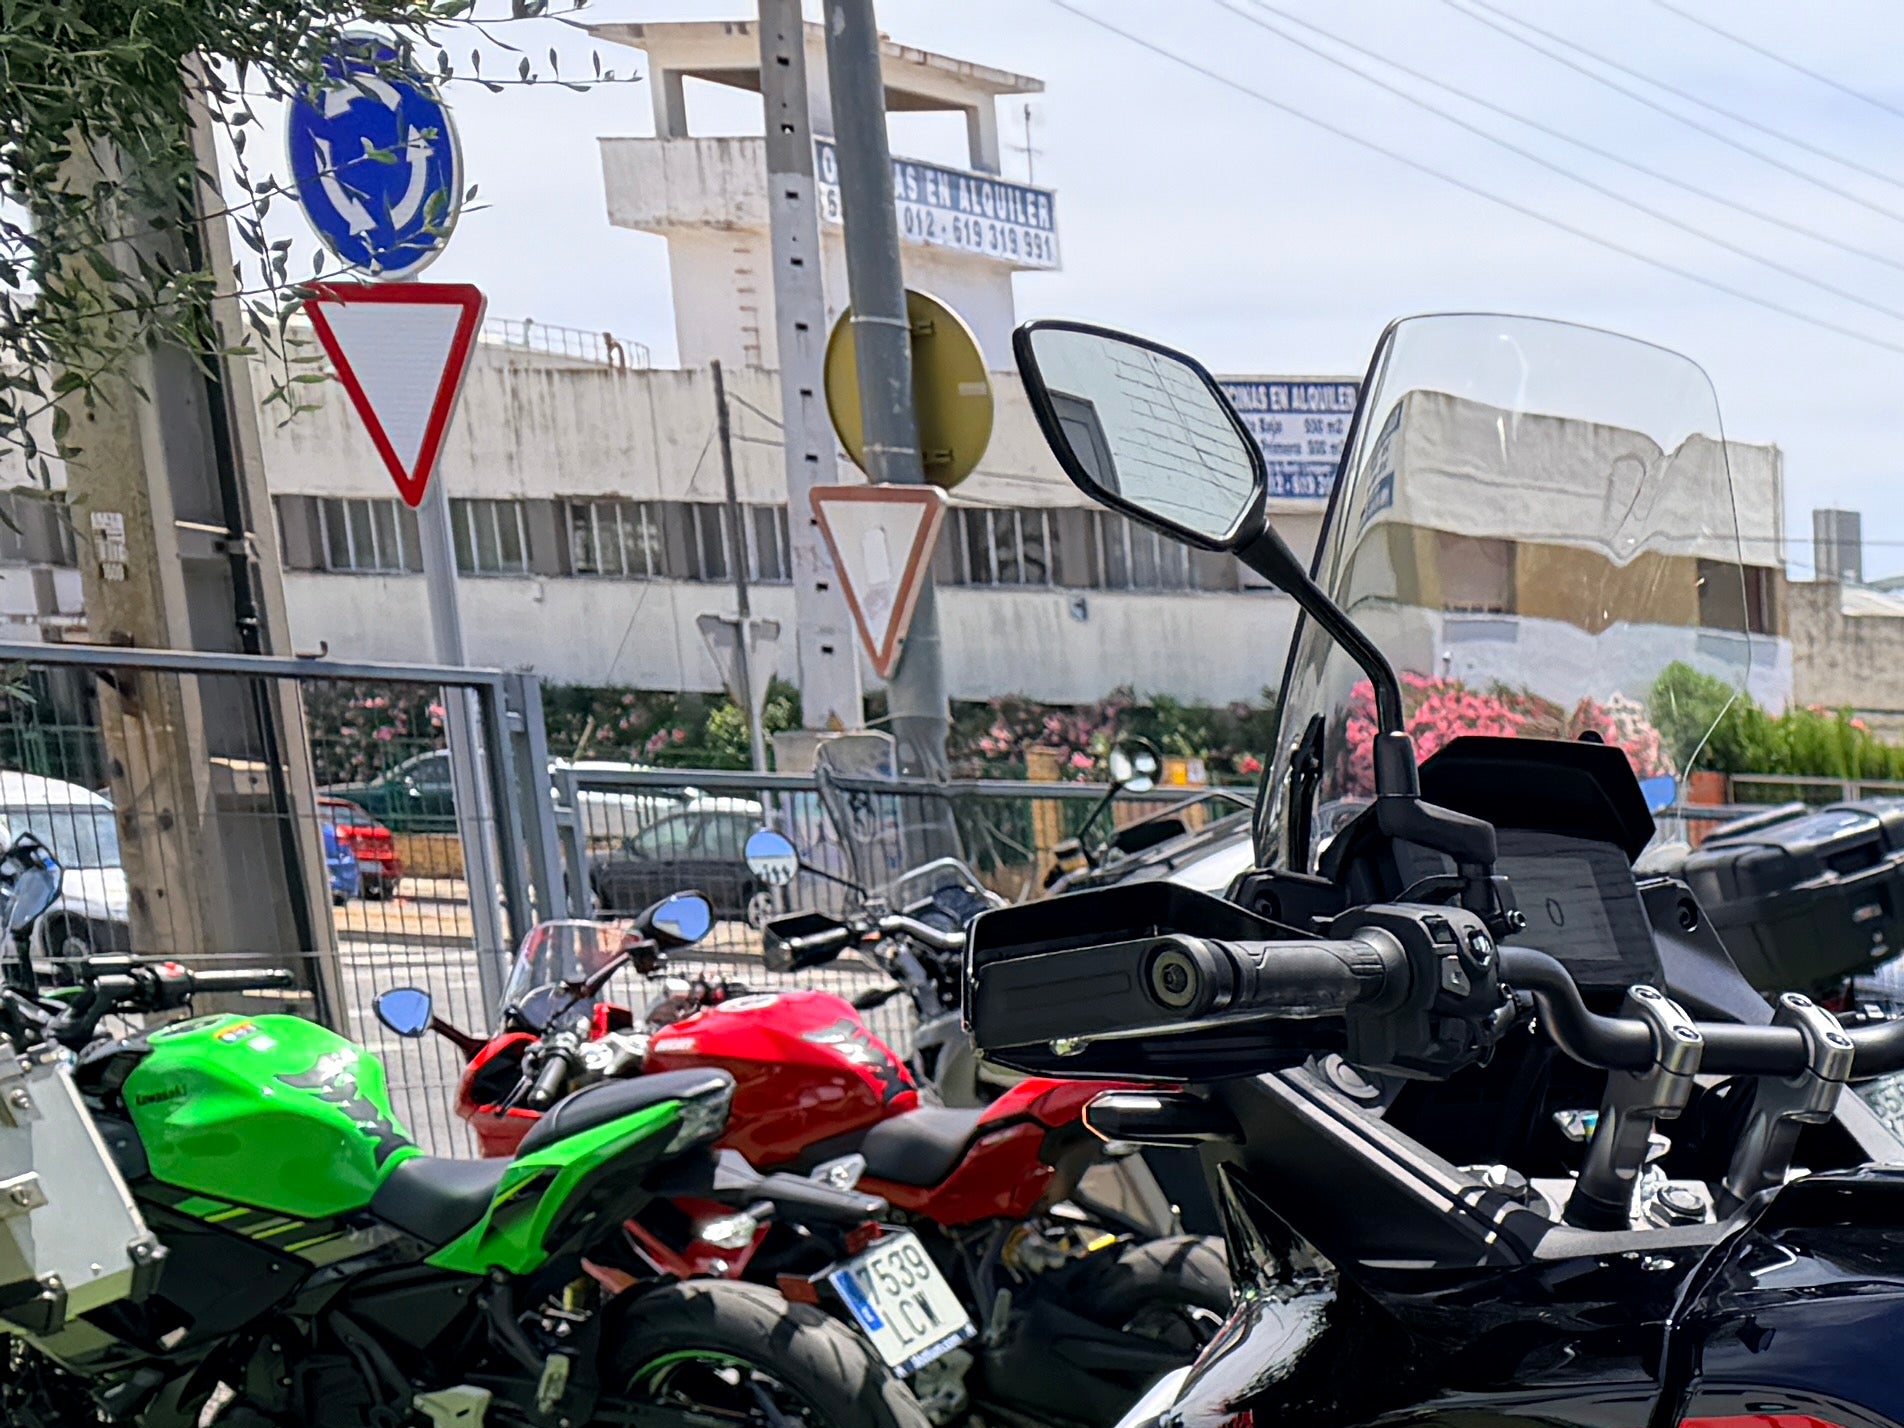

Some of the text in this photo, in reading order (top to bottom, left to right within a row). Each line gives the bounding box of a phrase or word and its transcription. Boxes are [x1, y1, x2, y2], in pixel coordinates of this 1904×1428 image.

[925, 168, 952, 207] EN
[958, 177, 1052, 230] ALQUILER
[952, 215, 983, 248] 619
[988, 222, 1018, 255] 319
[856, 1244, 931, 1305] 7539
